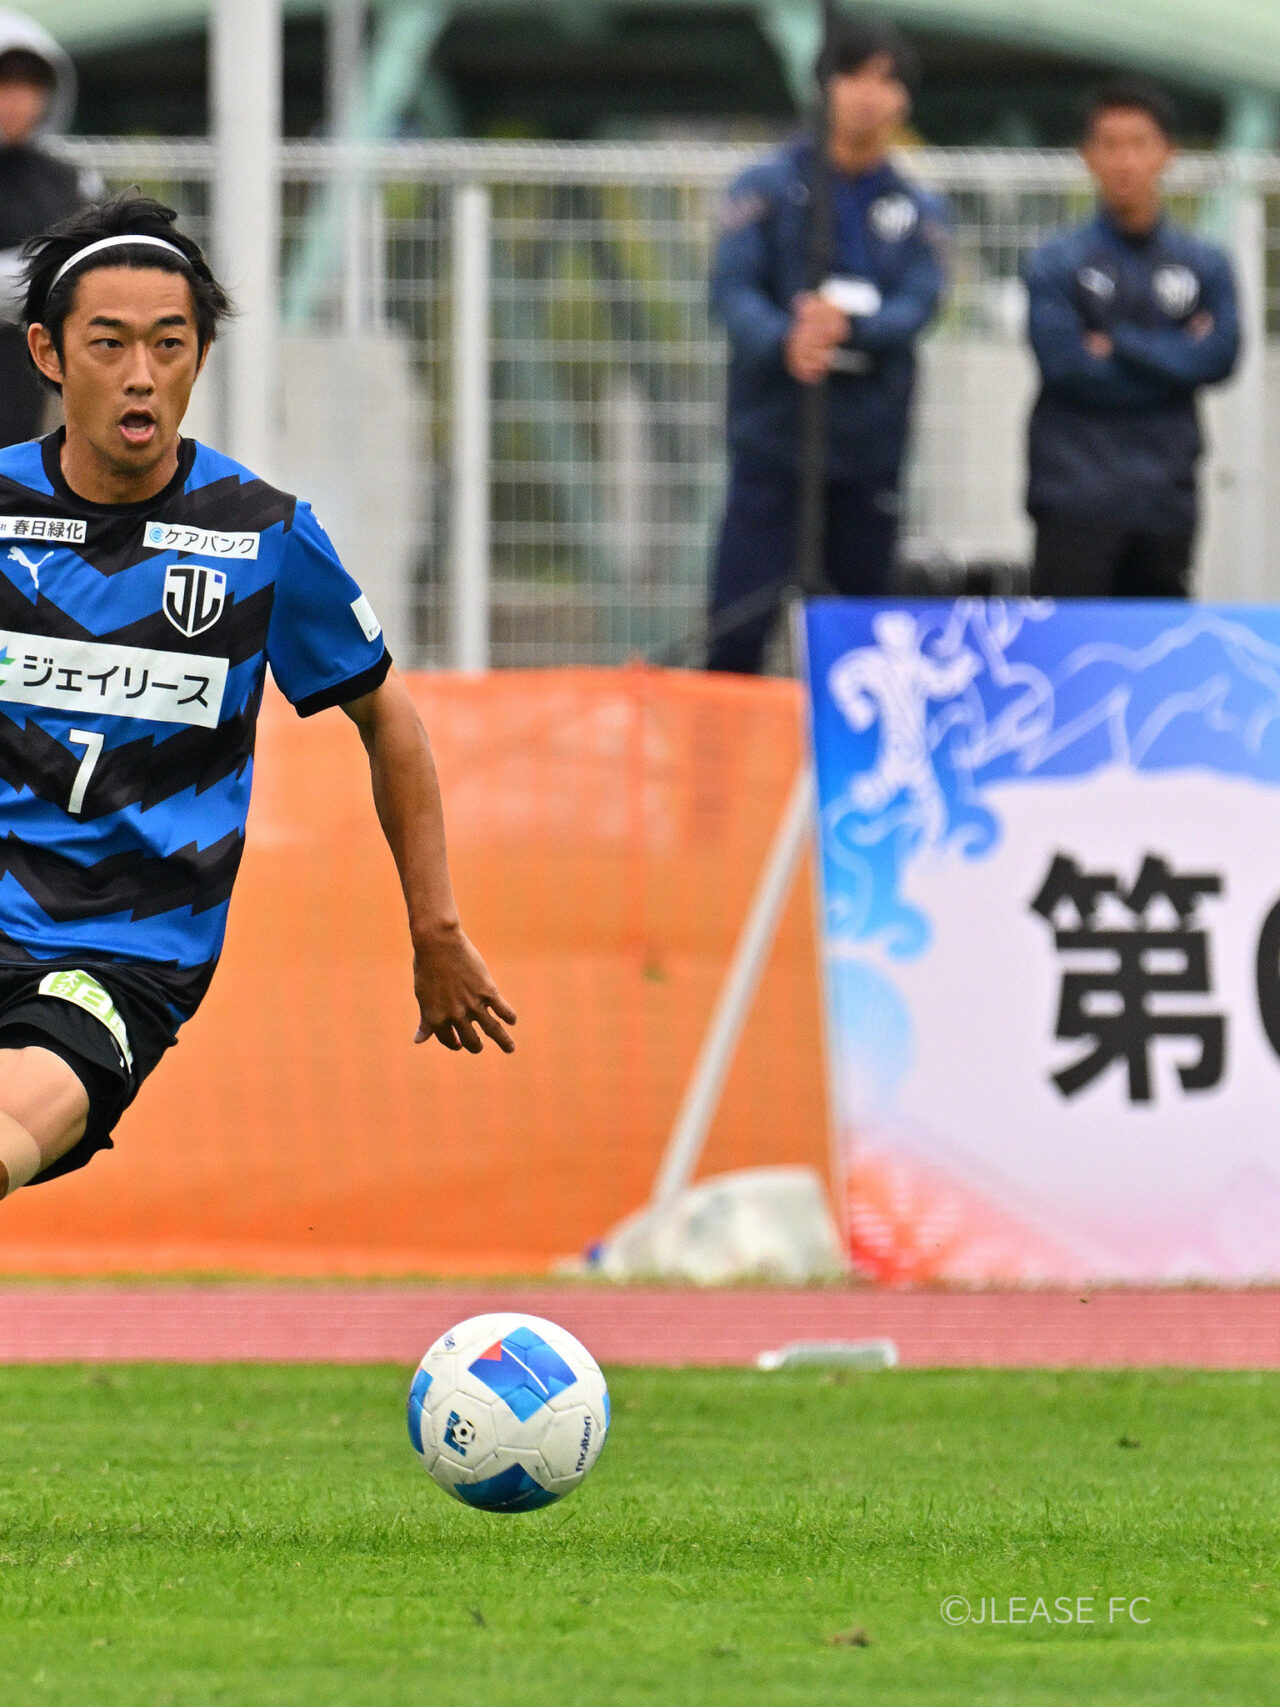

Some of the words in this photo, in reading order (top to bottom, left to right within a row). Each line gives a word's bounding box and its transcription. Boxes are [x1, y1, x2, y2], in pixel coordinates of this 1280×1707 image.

[12, 519, 84, 540] 春日緑化
[164, 528, 256, 554] ケアバンク
[23, 654, 210, 709] ジェイリース
[68, 728, 105, 814] 7
[1028, 848, 1280, 1109] 第
[575, 1416, 592, 1472] molten
